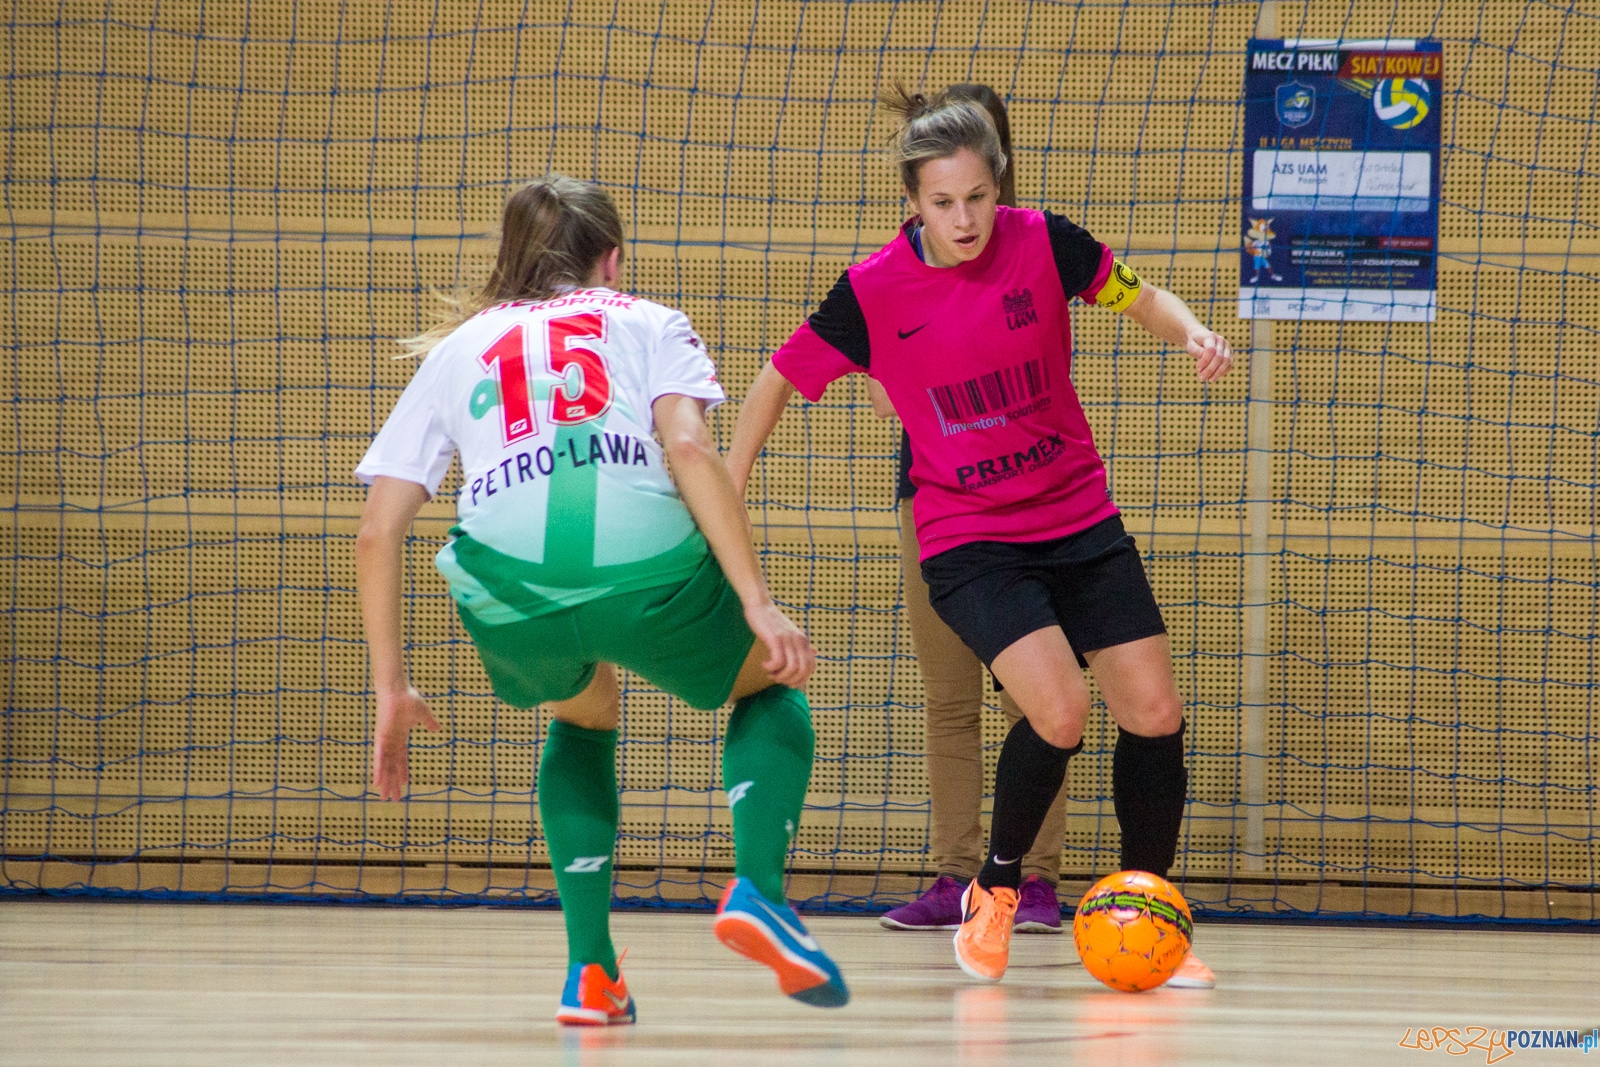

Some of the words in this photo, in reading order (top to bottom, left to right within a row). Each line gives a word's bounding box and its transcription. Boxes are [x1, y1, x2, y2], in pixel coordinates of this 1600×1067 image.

[1253, 52, 1294, 70] MECZ
[1297, 53, 1338, 71] PIŁKI
[1351, 56, 1440, 75] SIATKOWEJ
[1272, 163, 1294, 175] AZS
[1298, 163, 1328, 175] UAM
[1113, 261, 1141, 290] C
[1006, 309, 1039, 331] UAM
[476, 309, 615, 449] 15
[947, 415, 1007, 436] inventory
[471, 432, 649, 507] PETRO-LAWA
[956, 432, 1065, 485] PRIMEX
[961, 467, 1026, 492] TRANSPORT
